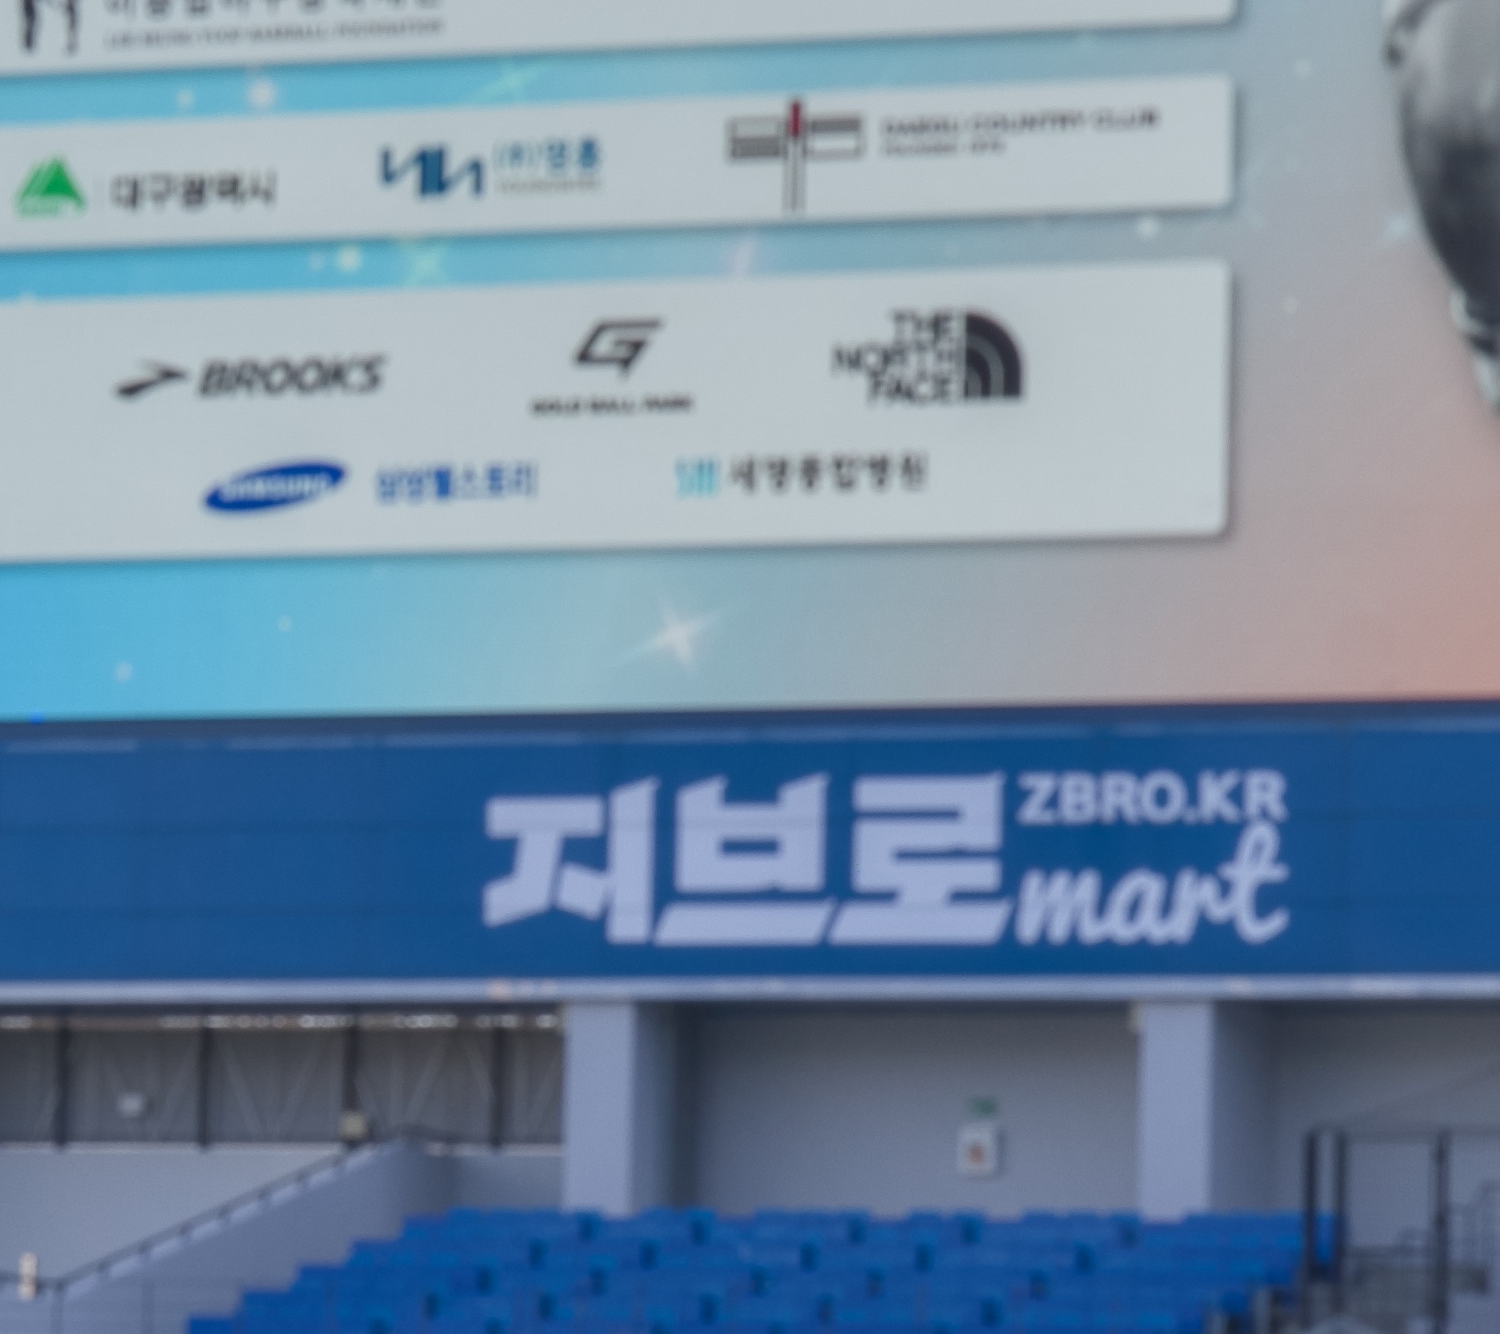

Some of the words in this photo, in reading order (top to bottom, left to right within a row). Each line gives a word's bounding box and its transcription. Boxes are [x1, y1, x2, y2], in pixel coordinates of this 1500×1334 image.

[893, 309, 957, 341] THE
[200, 355, 384, 395] BROOKS
[833, 344, 957, 375] NORTH
[868, 373, 957, 405] FACE
[1018, 771, 1287, 824] ZBRO.KR
[483, 773, 1010, 946] 지브로
[1015, 824, 1288, 945] mart
